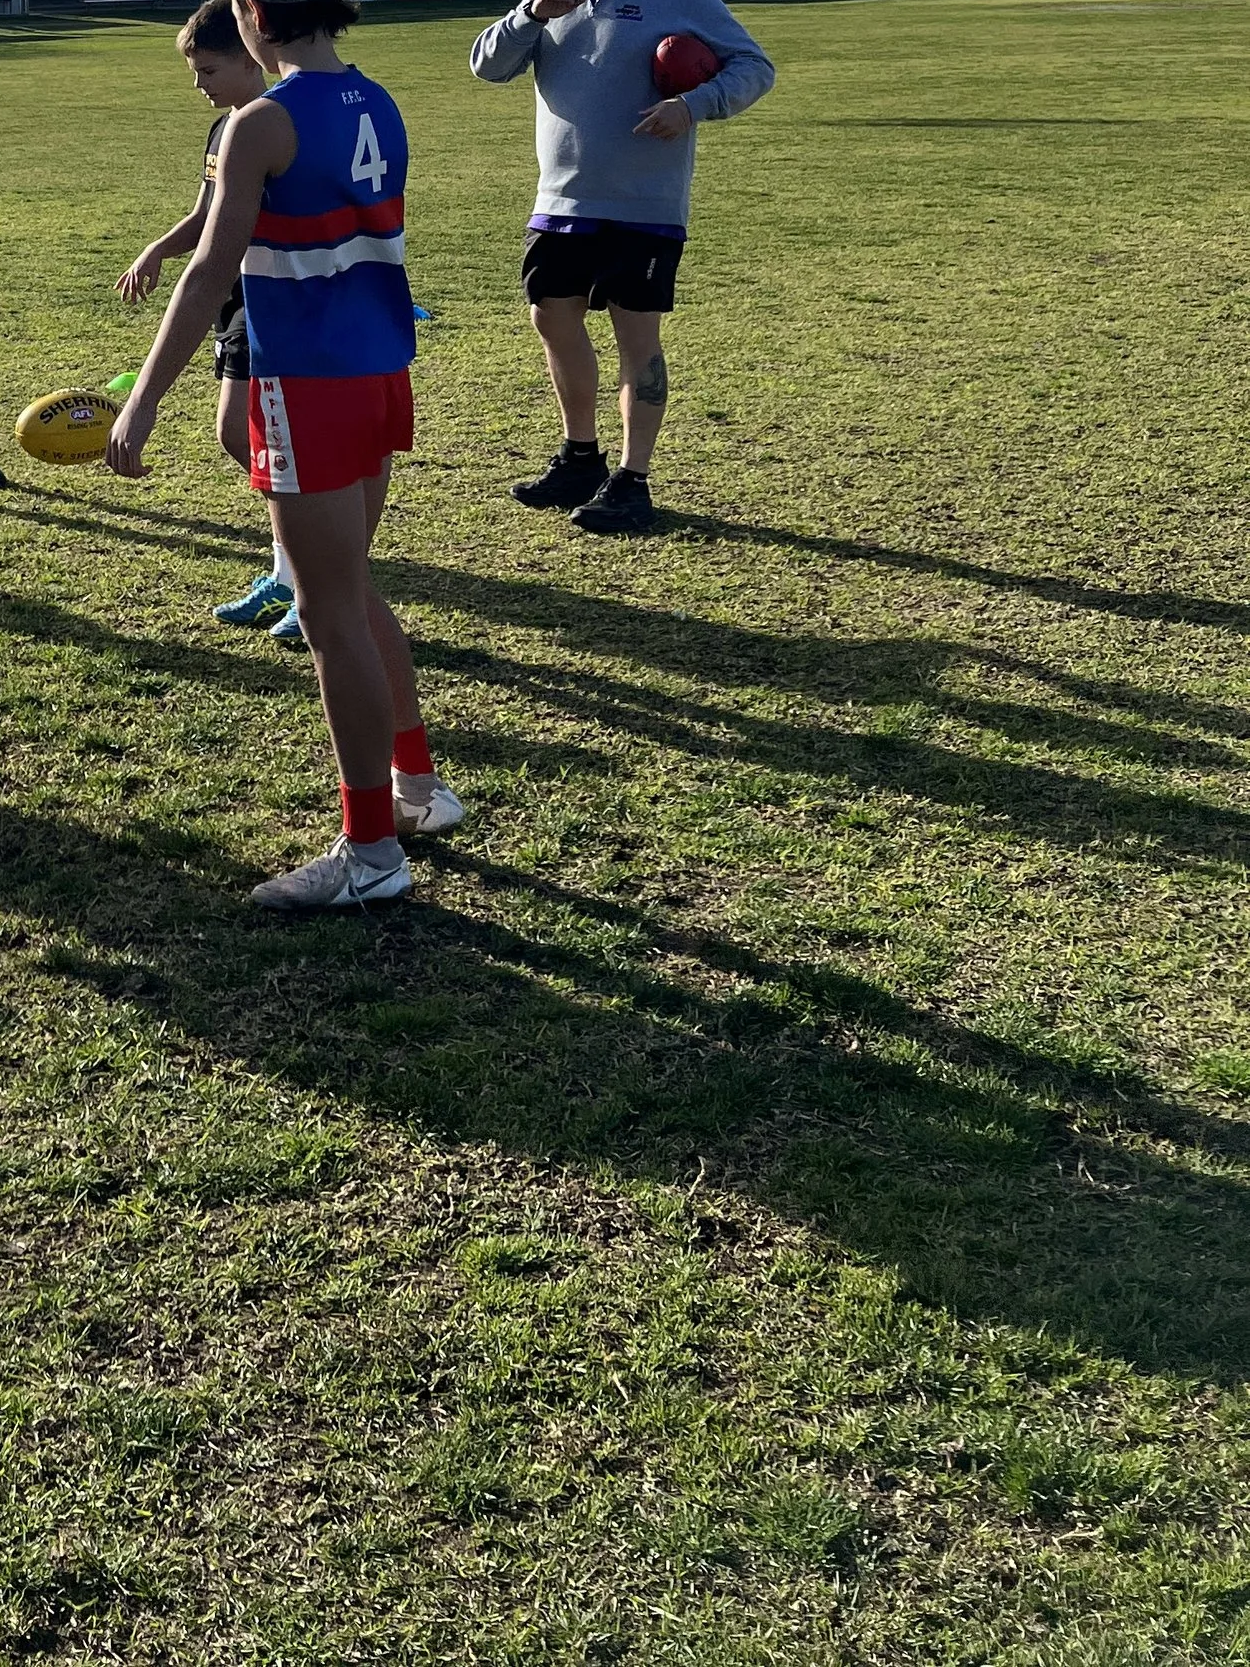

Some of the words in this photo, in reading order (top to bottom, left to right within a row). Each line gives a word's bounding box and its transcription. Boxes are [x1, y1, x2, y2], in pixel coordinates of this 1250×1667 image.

[351, 113, 388, 193] 4
[39, 396, 119, 425] SHERRIN
[72, 409, 94, 419] AFL
